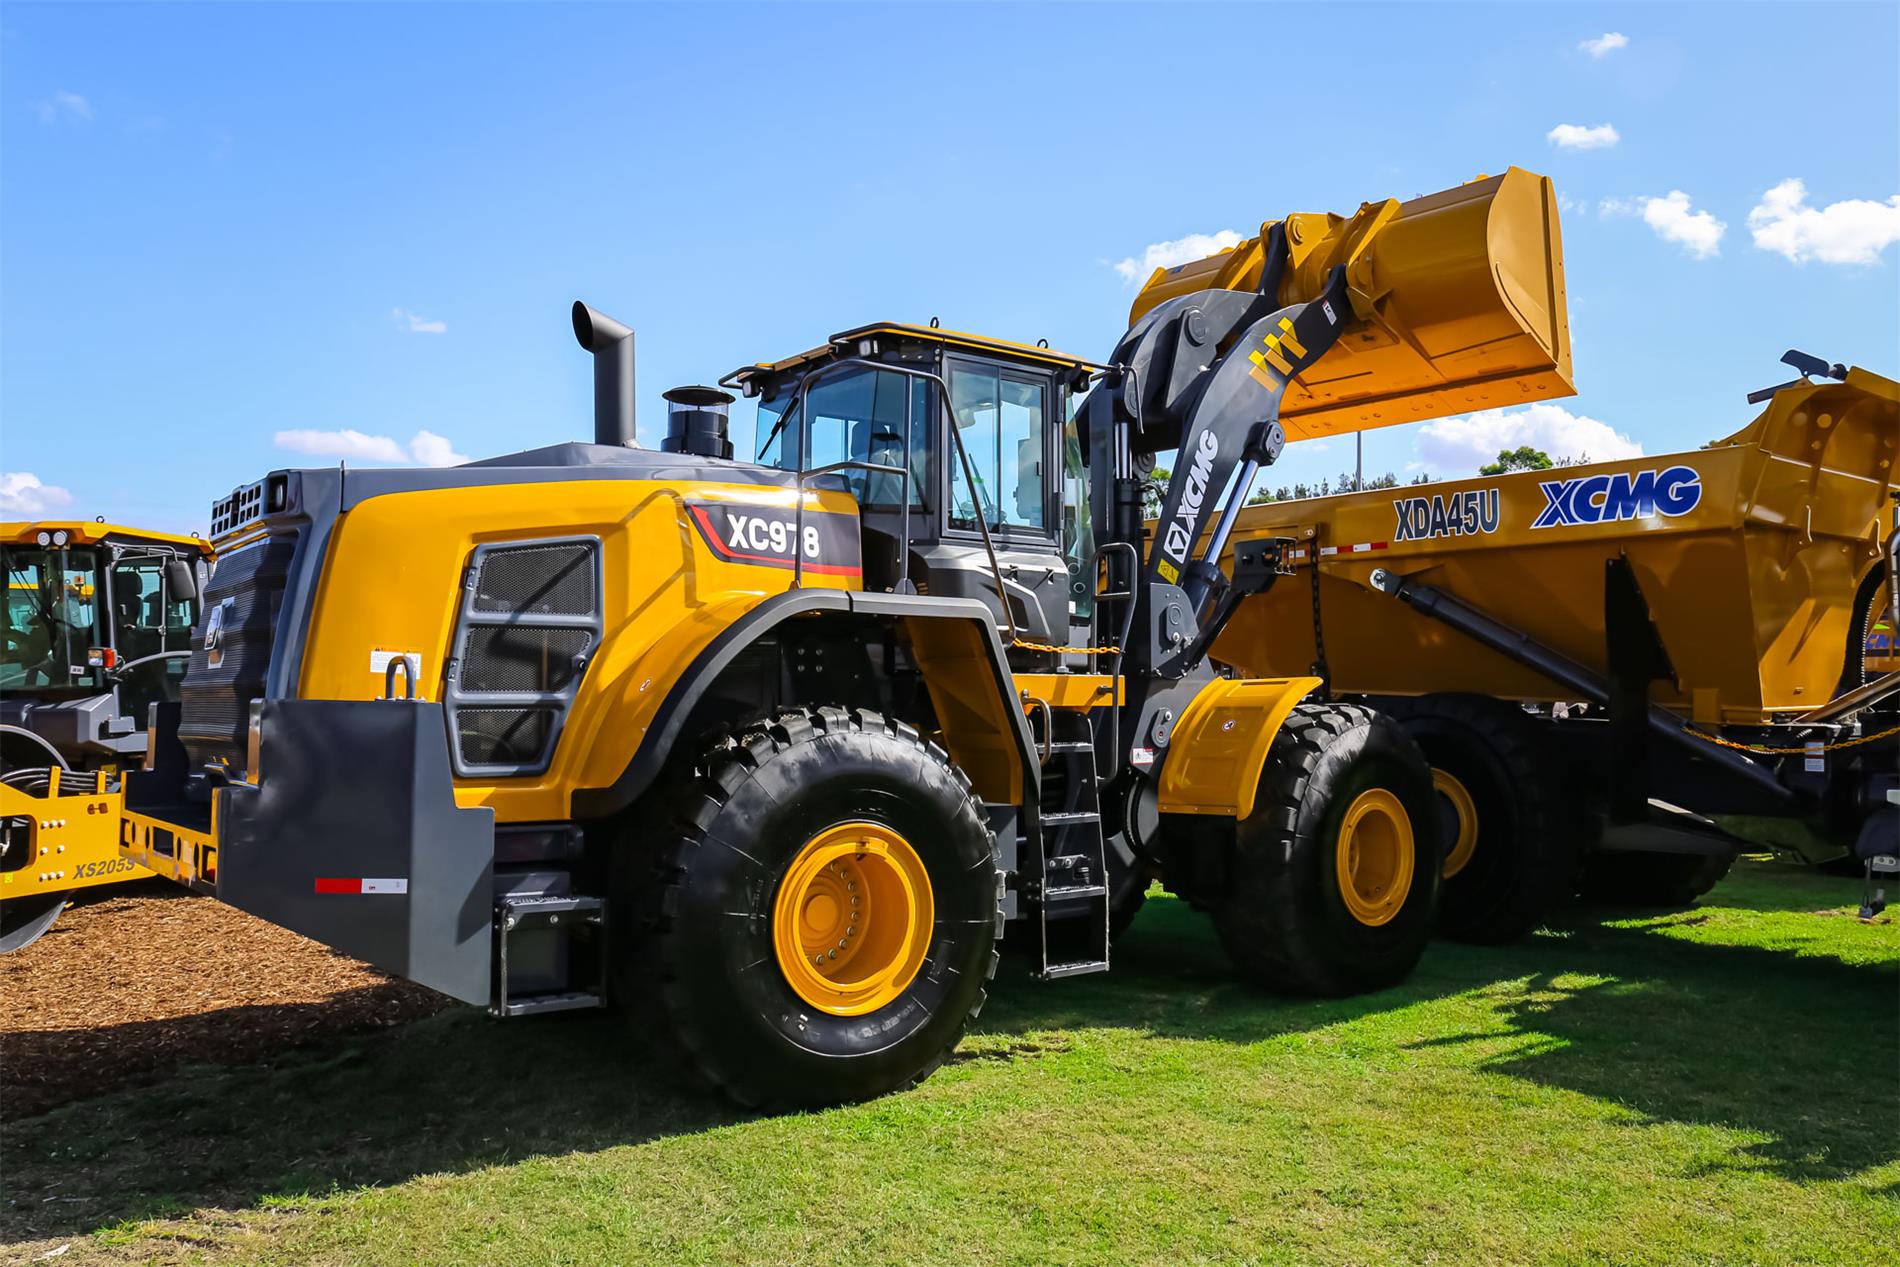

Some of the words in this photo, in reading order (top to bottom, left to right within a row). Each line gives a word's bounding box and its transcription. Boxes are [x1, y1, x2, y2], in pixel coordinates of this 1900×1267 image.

[1176, 429, 1219, 536] XCMG
[1529, 465, 1703, 530] XCMG
[726, 513, 820, 558] XC978
[1393, 488, 1500, 542] XDA45U
